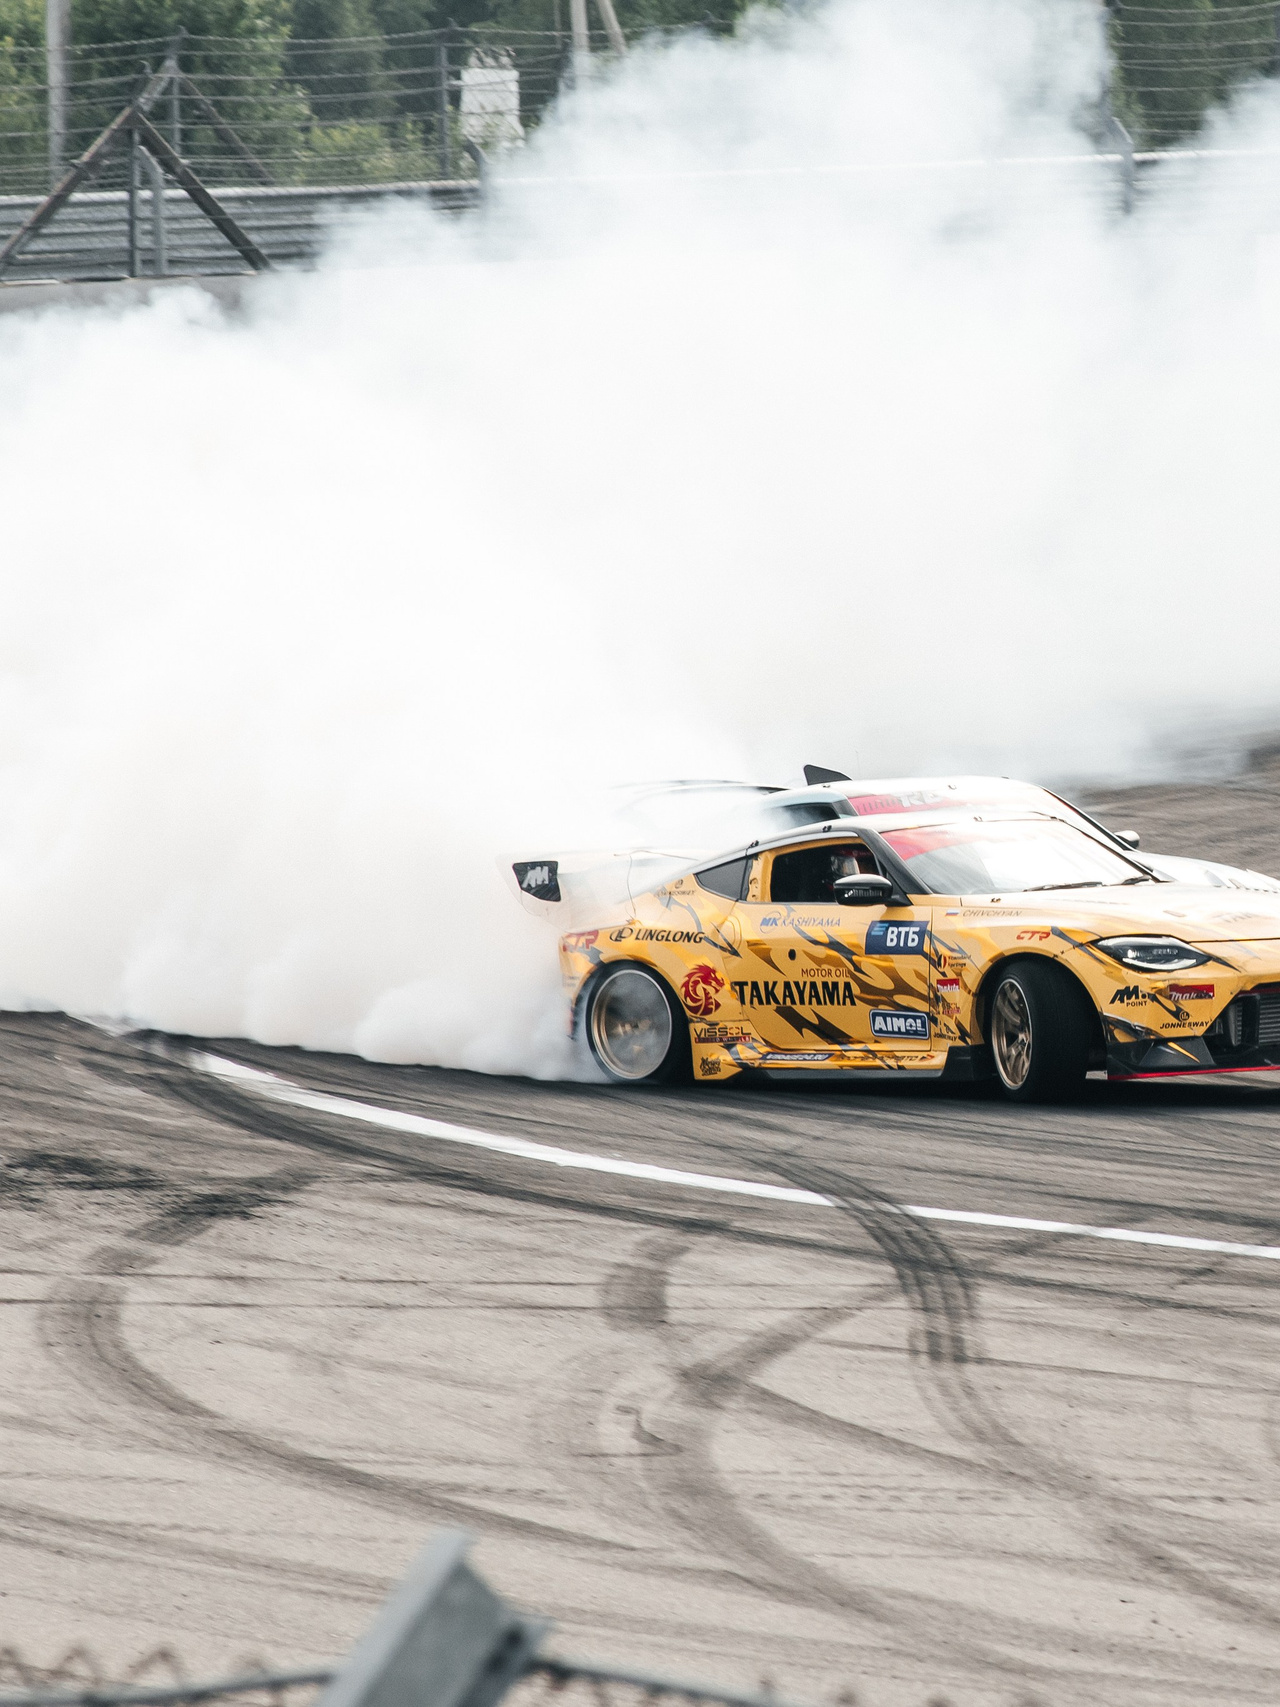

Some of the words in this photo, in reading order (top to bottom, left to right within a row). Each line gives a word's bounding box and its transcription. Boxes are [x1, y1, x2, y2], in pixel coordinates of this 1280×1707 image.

[781, 917, 841, 927] KASHIYAMA
[635, 928, 705, 943] LINGLONG
[886, 926, 921, 948] ВТБ
[801, 968, 834, 978] MOTOR
[835, 969, 850, 978] OIL
[732, 980, 857, 1006] TAKAYAMA
[874, 1016, 926, 1032] AIMOL
[1160, 1020, 1210, 1029] JONNESWAY
[694, 1026, 752, 1038] VISSOL
